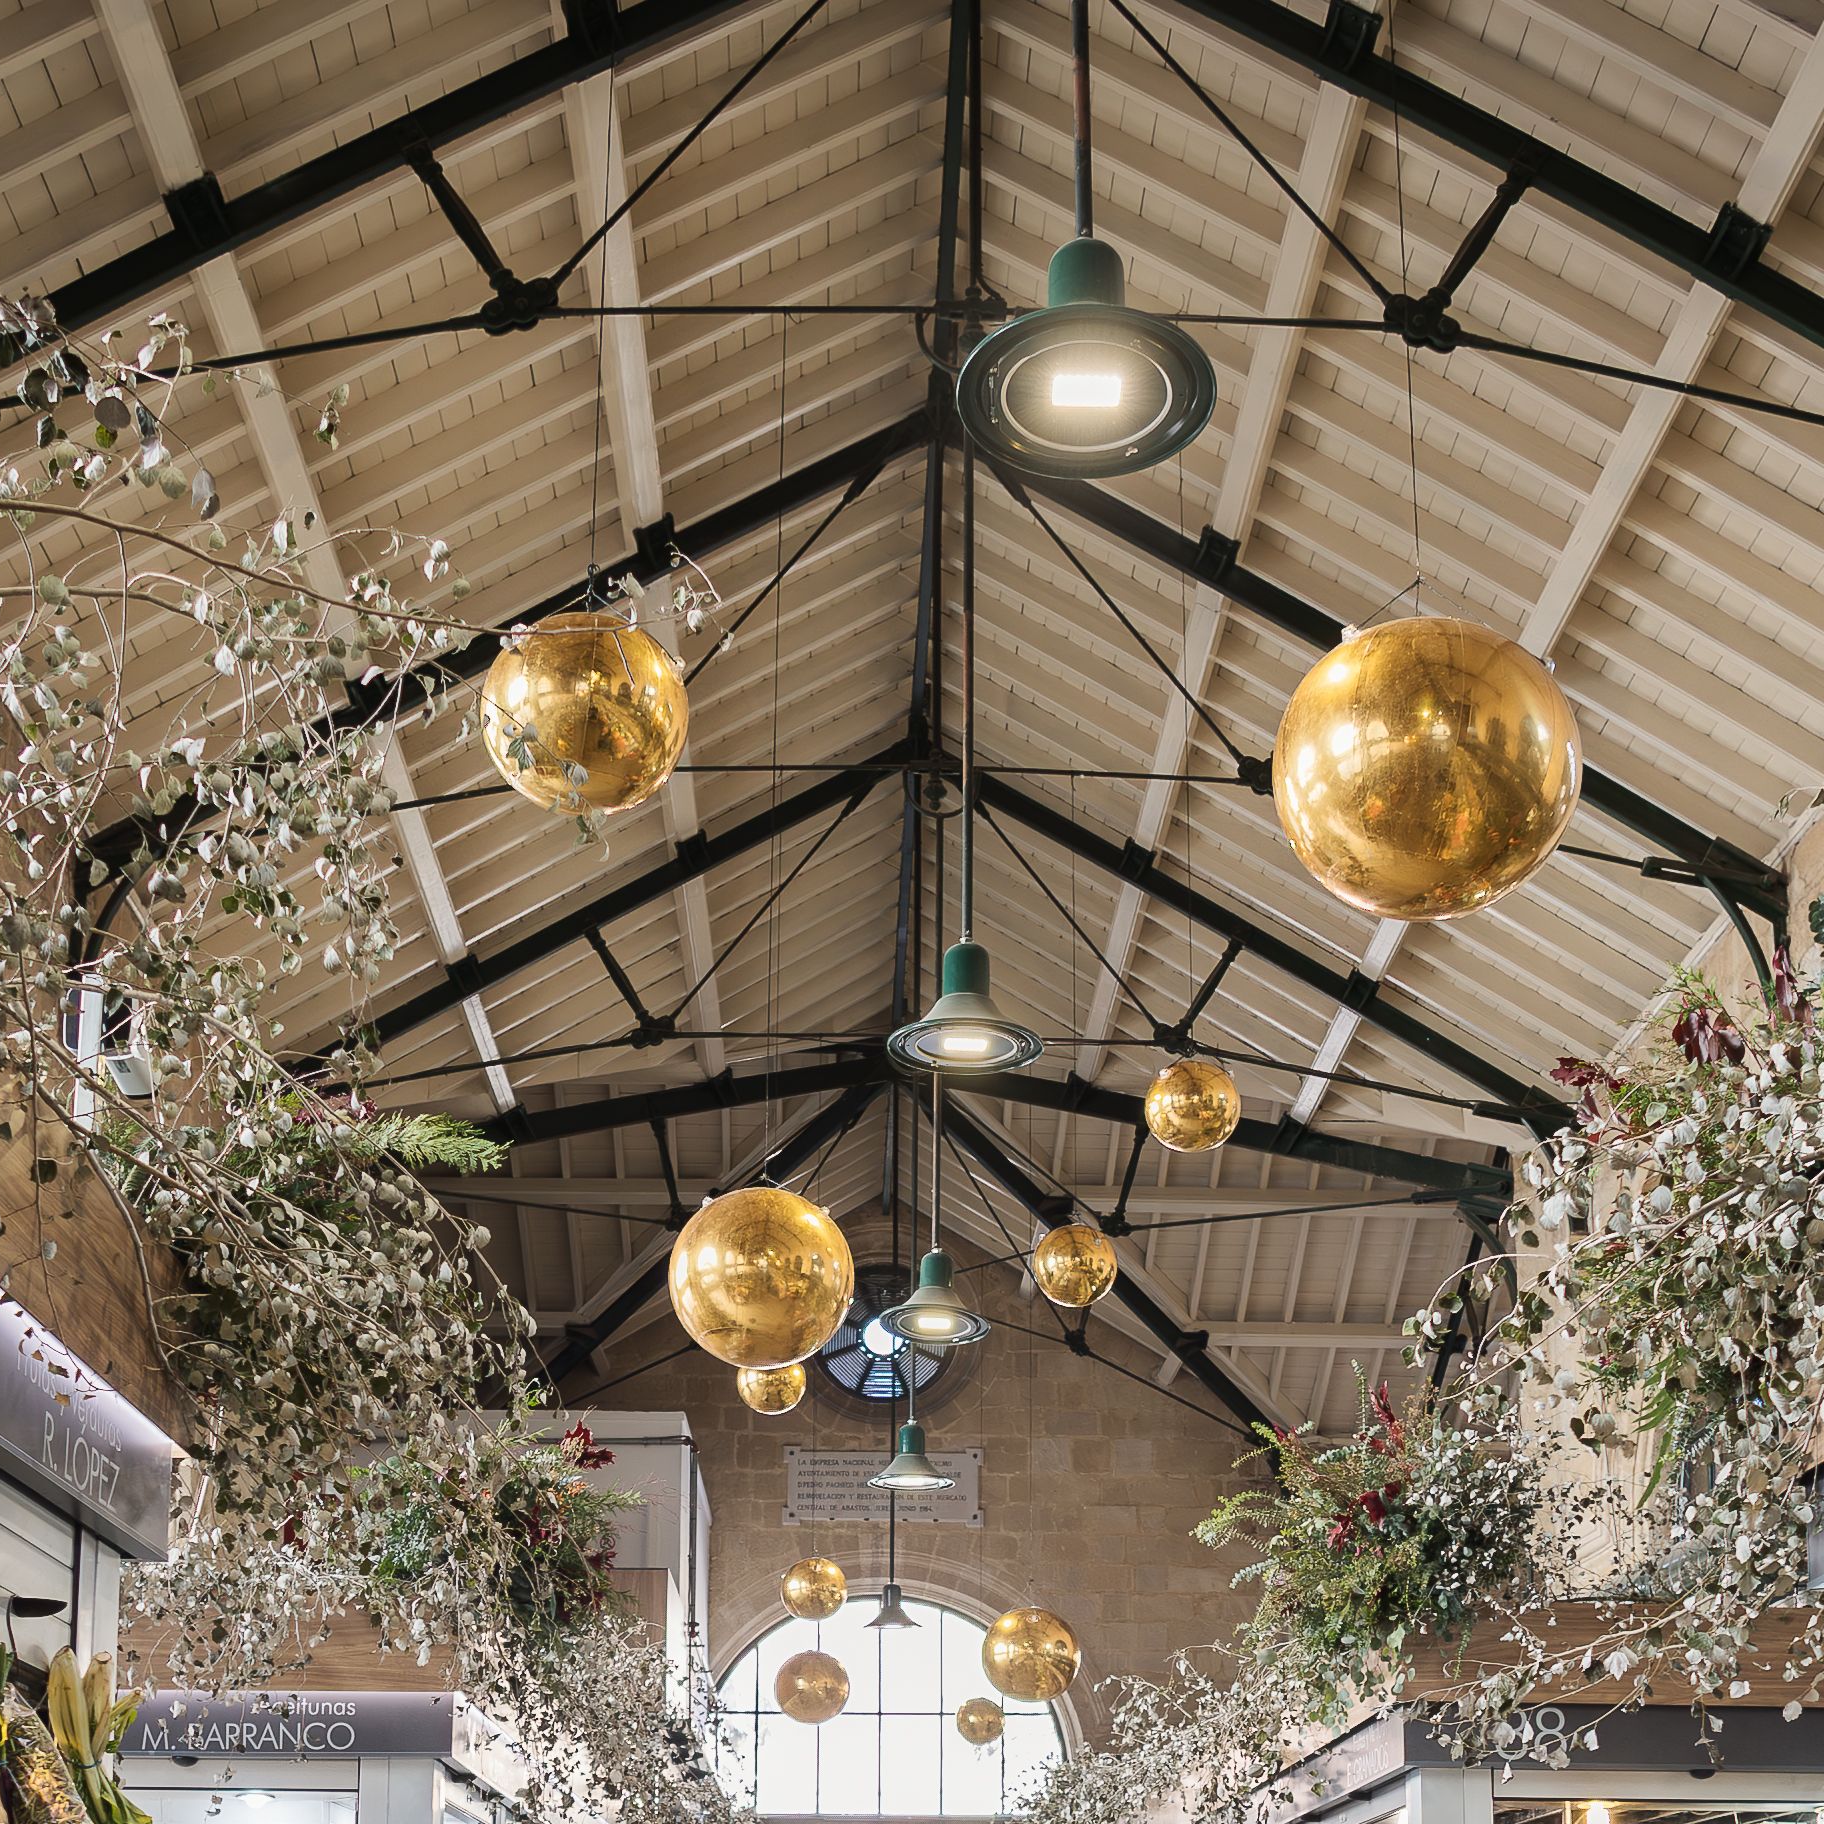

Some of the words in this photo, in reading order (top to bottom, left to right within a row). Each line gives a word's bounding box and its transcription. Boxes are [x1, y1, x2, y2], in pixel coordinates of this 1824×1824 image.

[42, 1410, 58, 1472] R.
[63, 1423, 122, 1513] LÓPEZ
[141, 1722, 176, 1751] M.
